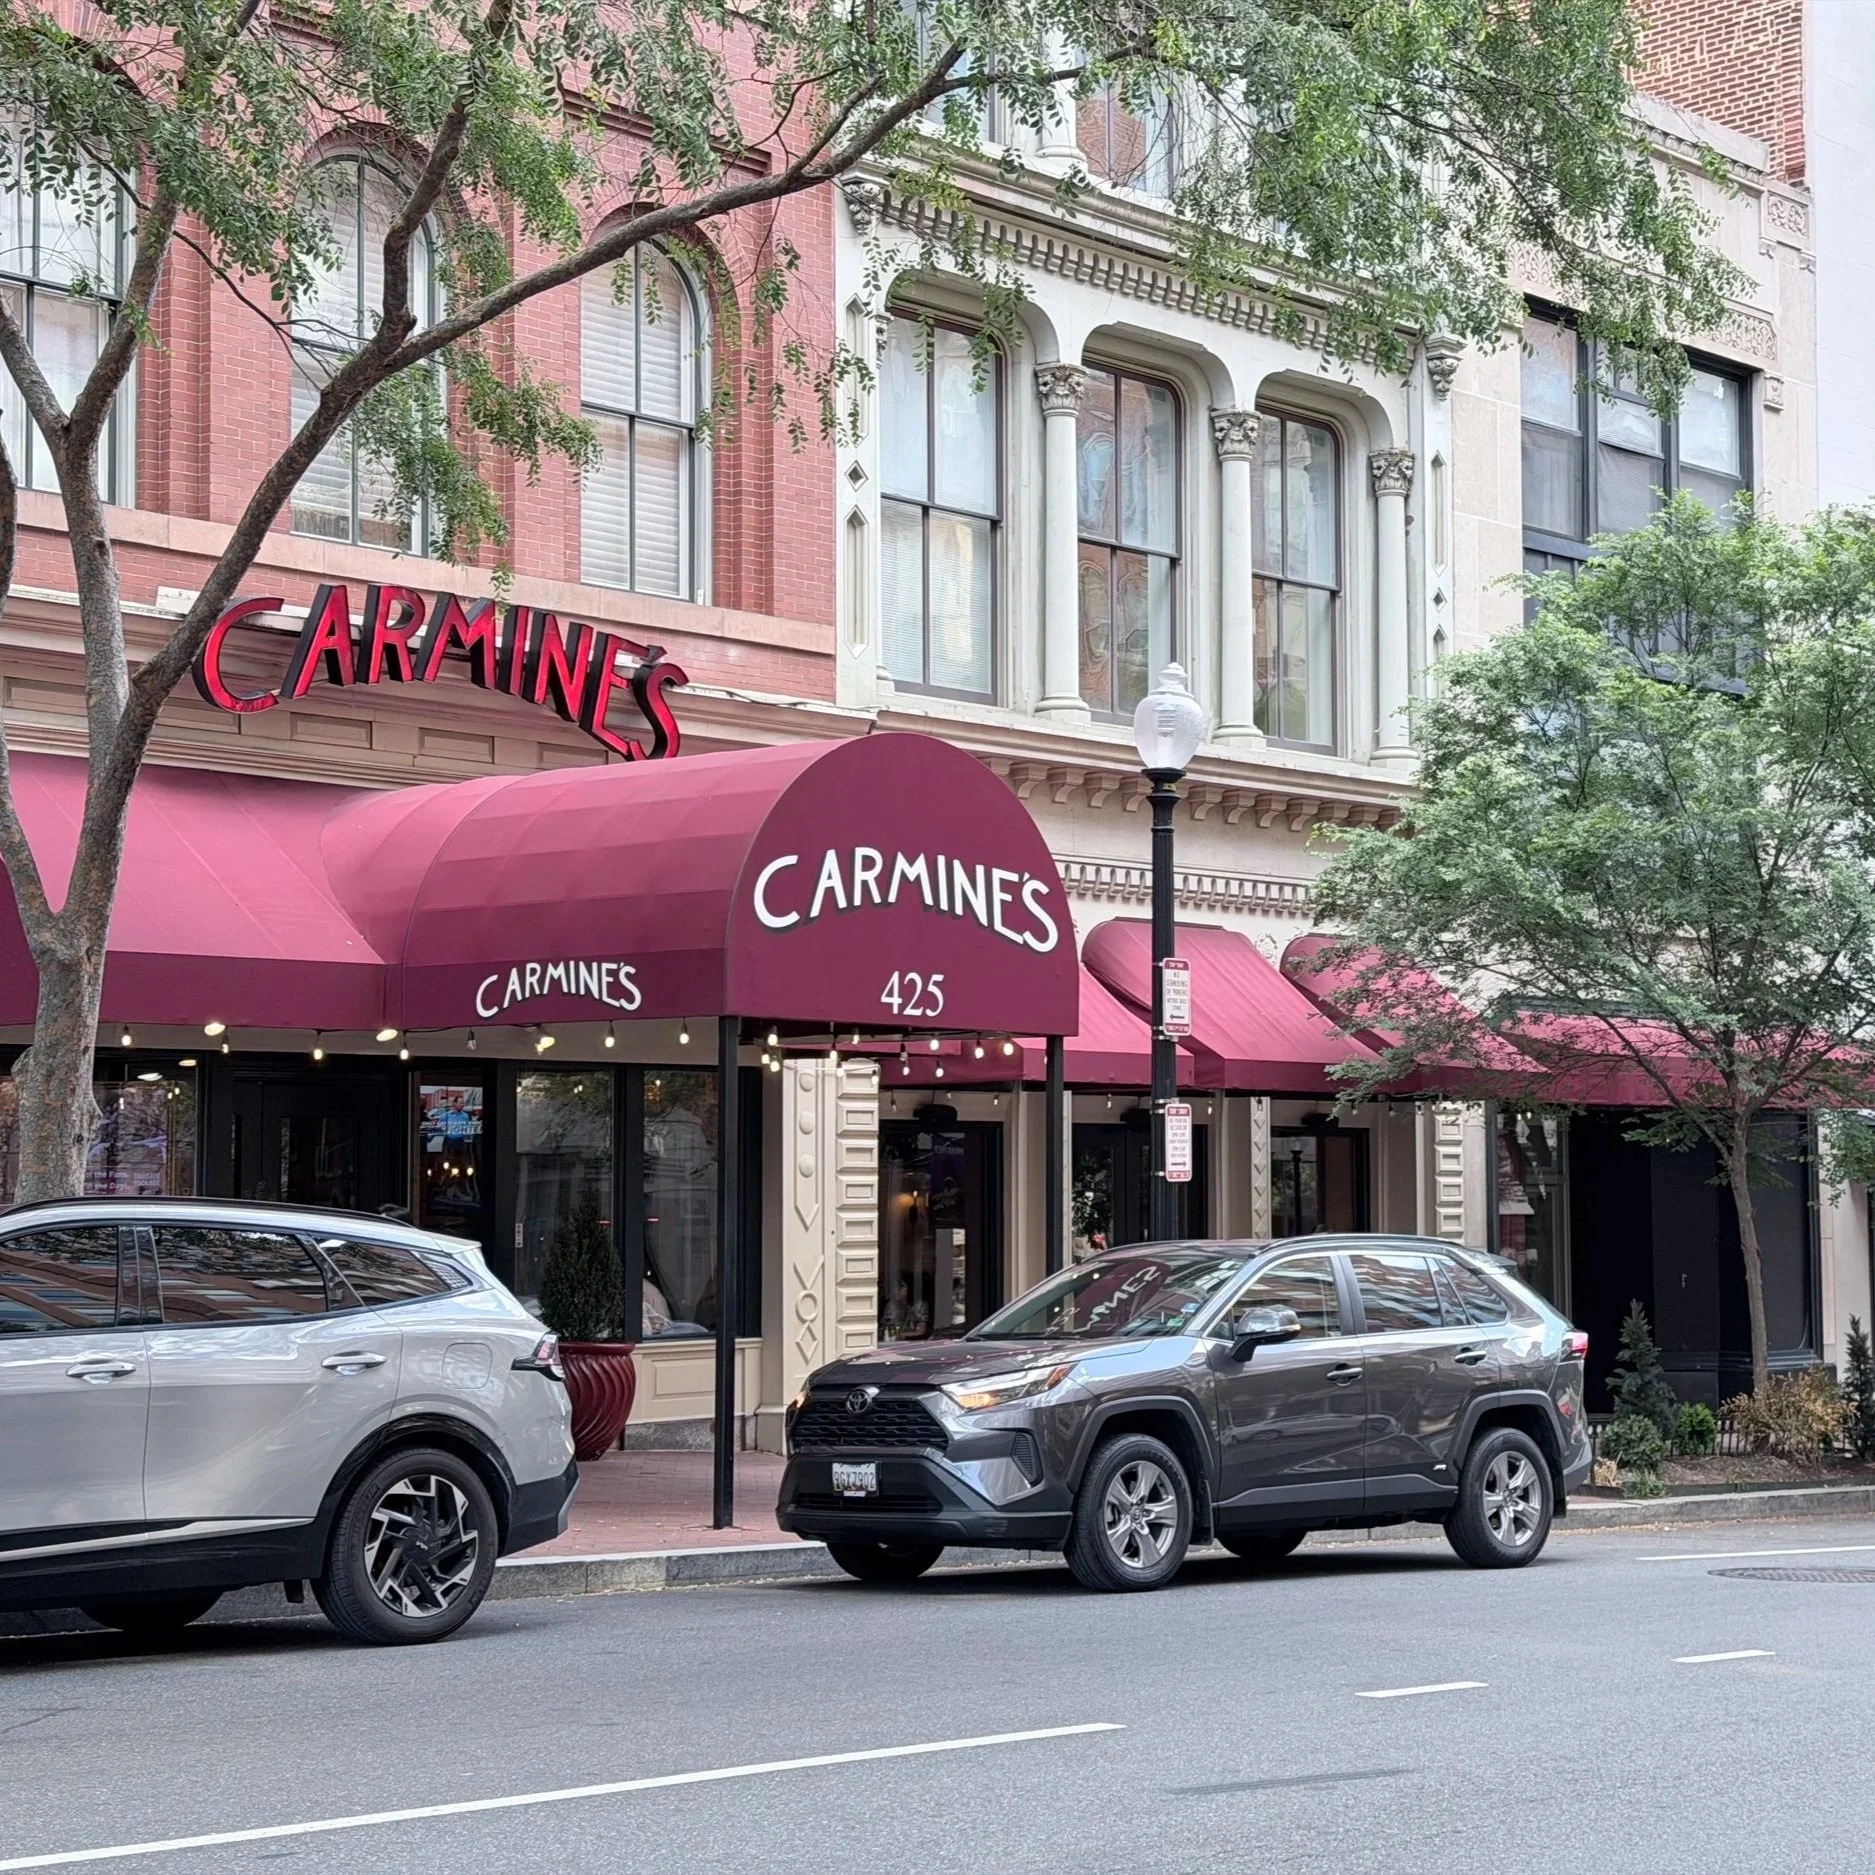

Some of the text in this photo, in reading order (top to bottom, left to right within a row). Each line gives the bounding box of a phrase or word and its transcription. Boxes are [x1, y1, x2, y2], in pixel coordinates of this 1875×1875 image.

[192, 584, 689, 761] CARMINE'S
[753, 847, 1059, 953] CARMINE'S
[476, 960, 642, 1018] CARMINE'S
[880, 971, 945, 1017] 425
